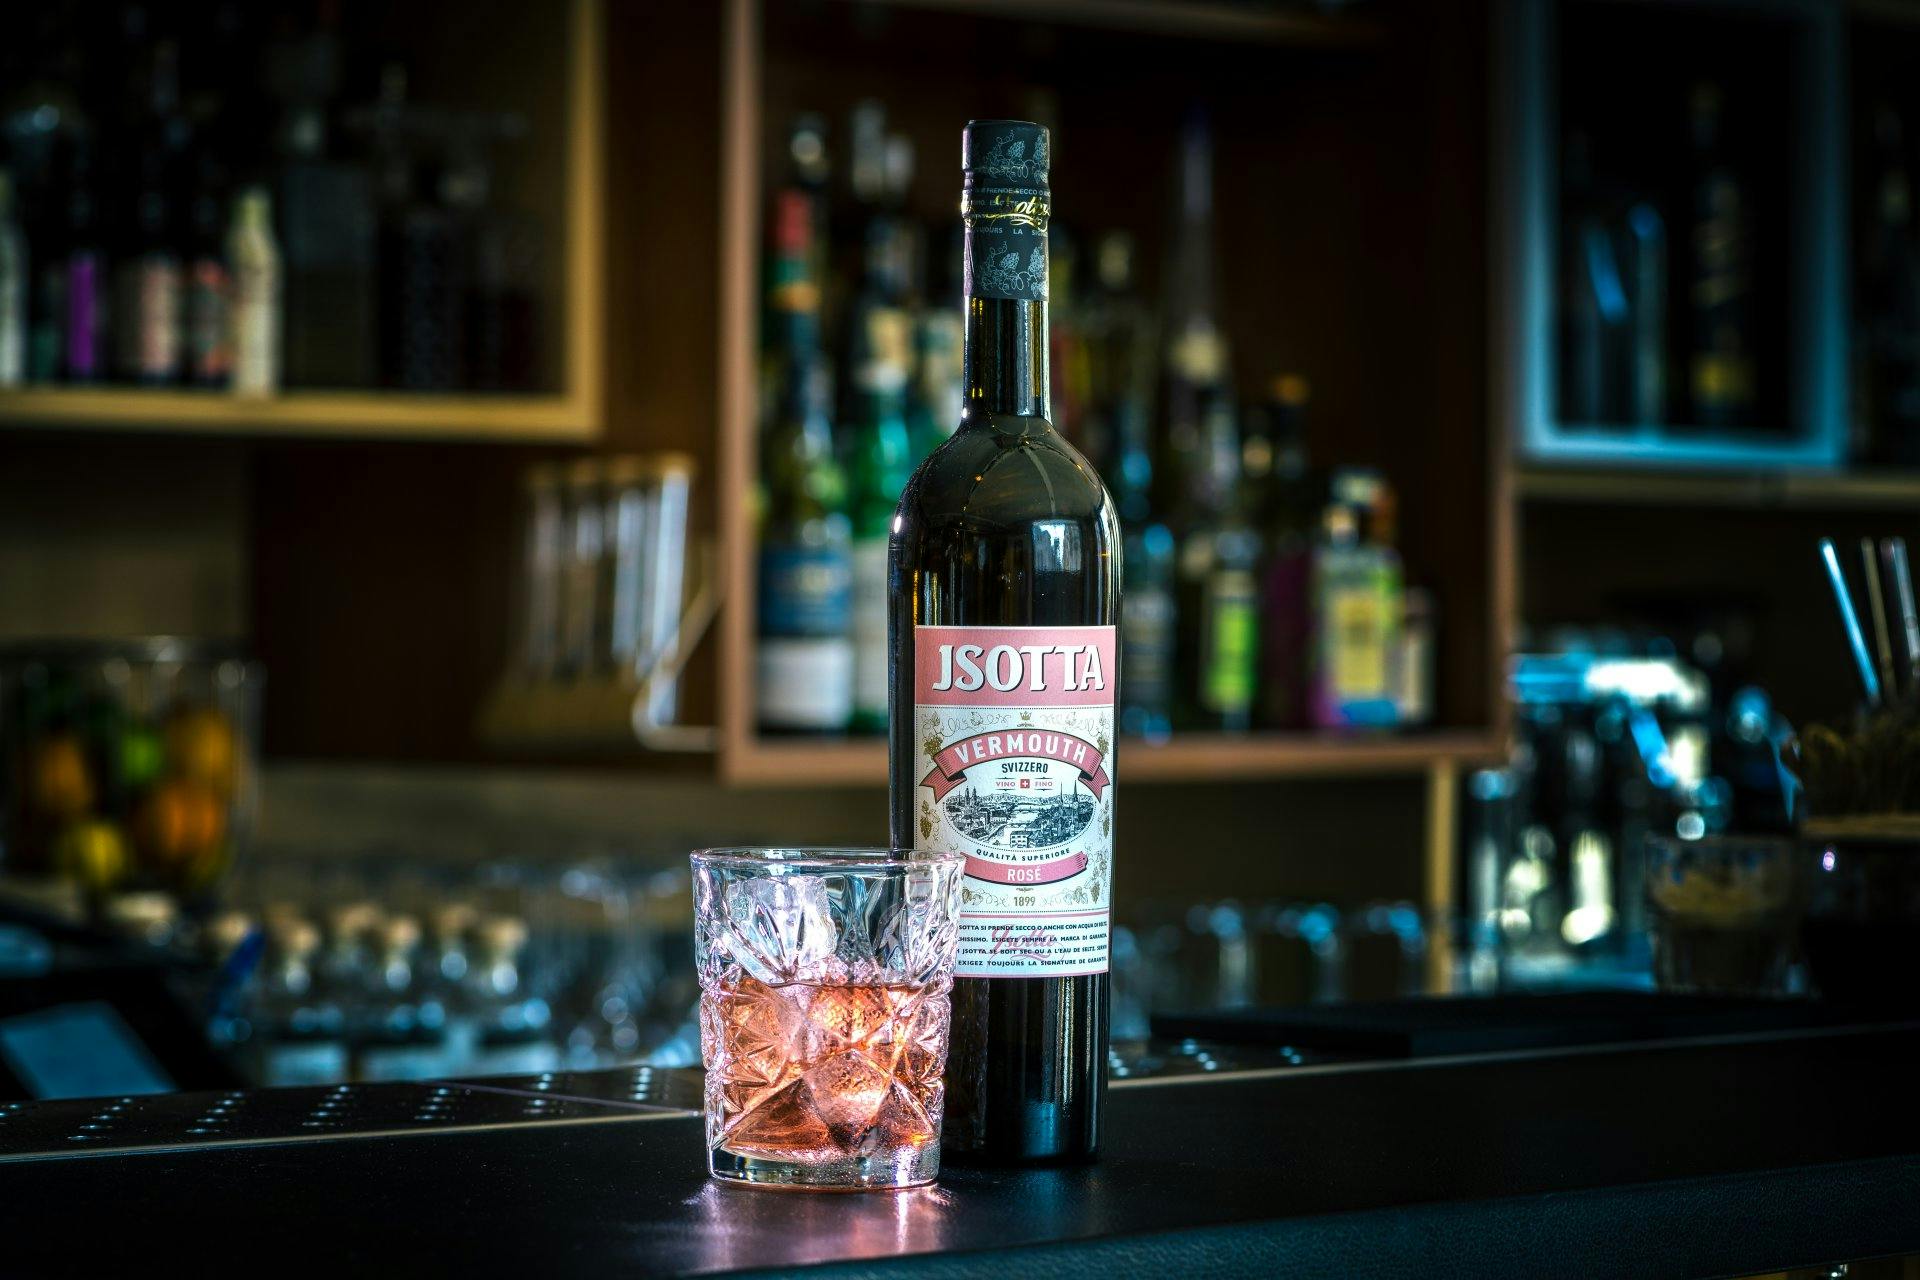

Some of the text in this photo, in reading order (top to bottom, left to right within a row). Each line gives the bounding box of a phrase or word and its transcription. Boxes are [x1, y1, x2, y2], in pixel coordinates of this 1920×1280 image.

[931, 644, 1105, 692] JSOTTA
[954, 733, 1087, 764] VERMOUTH
[1001, 762, 1049, 774] SVIZZERO
[996, 780, 1053, 788] VINO FINO
[976, 847, 1070, 861] QUALITÀ SUPERIORE
[1007, 864, 1042, 881] ROSÉ
[1013, 896, 1036, 907] 1899
